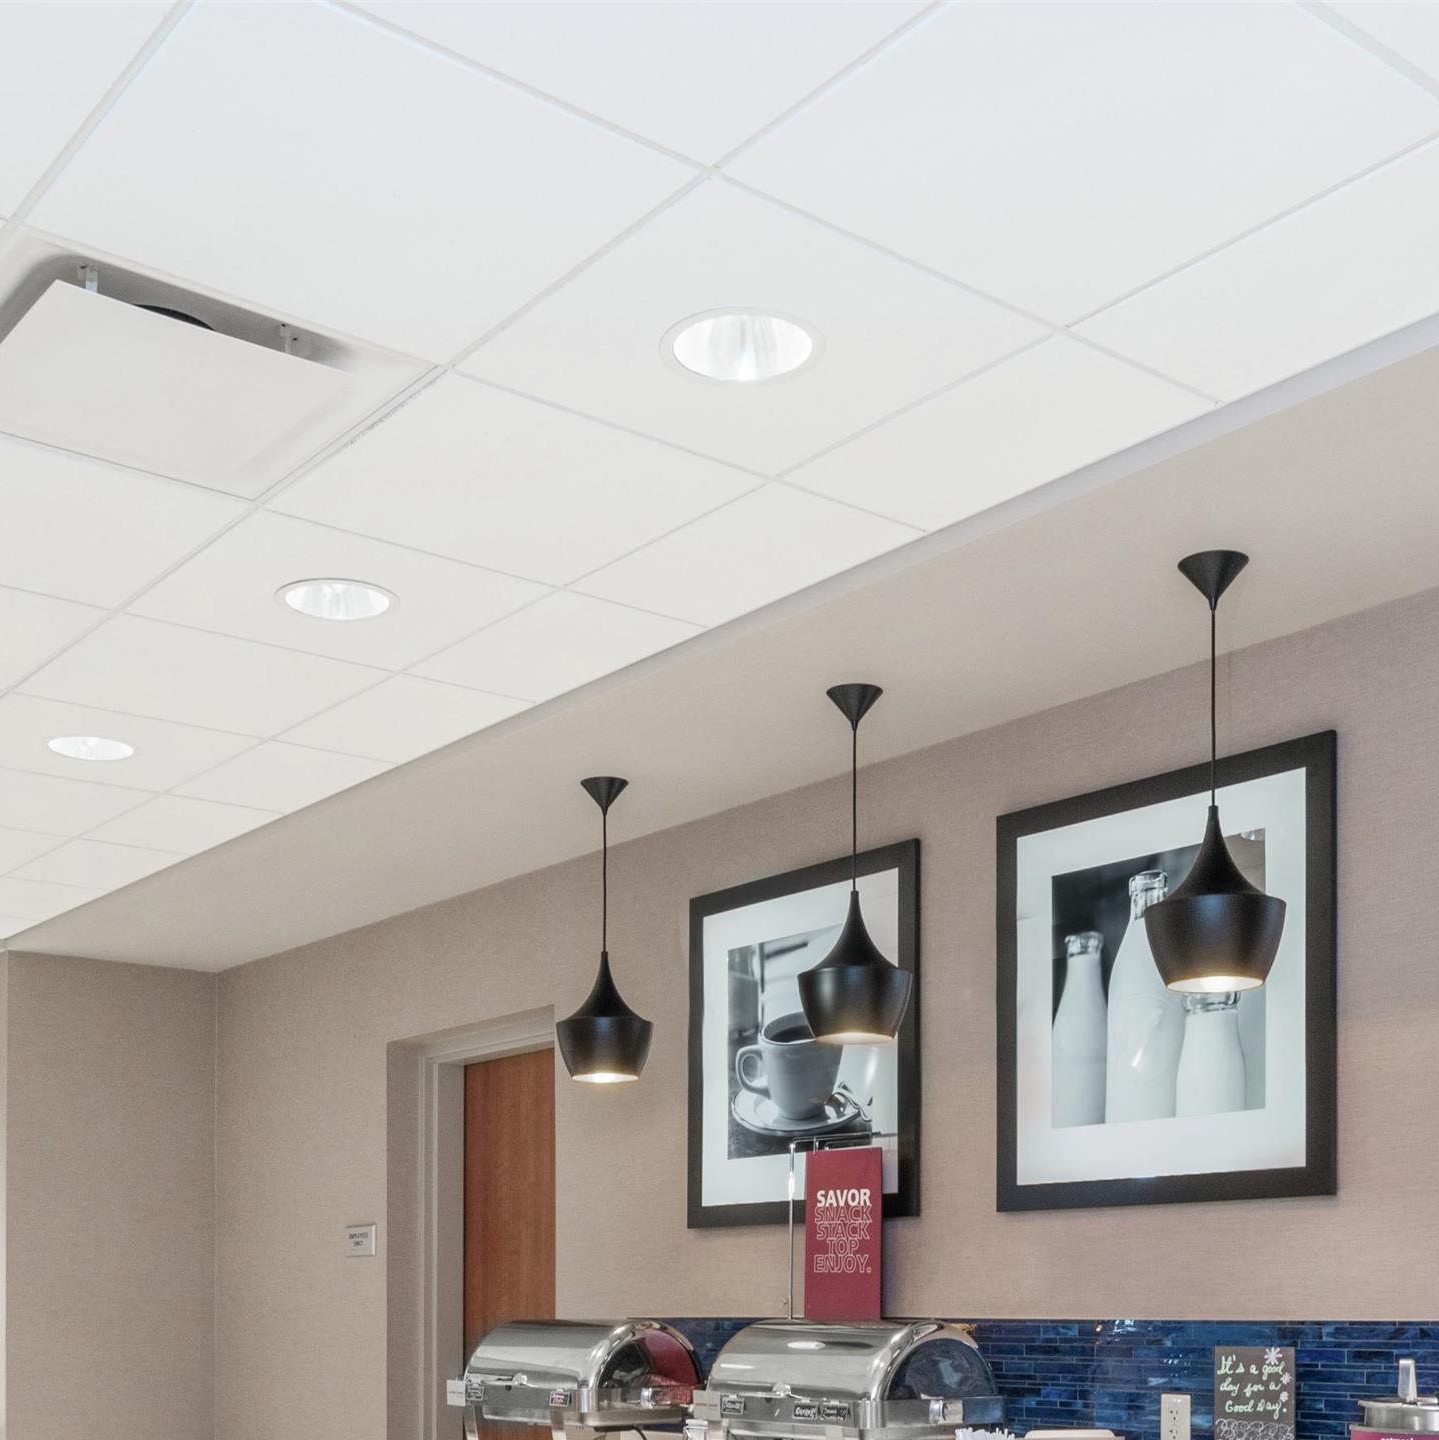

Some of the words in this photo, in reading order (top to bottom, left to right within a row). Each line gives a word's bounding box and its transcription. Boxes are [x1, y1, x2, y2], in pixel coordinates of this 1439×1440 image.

[816, 1188, 871, 1207] SAVOR
[814, 1204, 872, 1223] SNACK
[816, 1219, 870, 1240] STACK
[826, 1238, 859, 1256] TOP
[813, 1254, 872, 1273] ENJOY.
[1217, 1354, 1245, 1375] It's
[1249, 1364, 1259, 1375] a
[1262, 1361, 1285, 1381] good
[1219, 1377, 1240, 1397] day
[1243, 1383, 1265, 1398] for
[1269, 1381, 1281, 1391] a
[1225, 1400, 1254, 1413] Good
